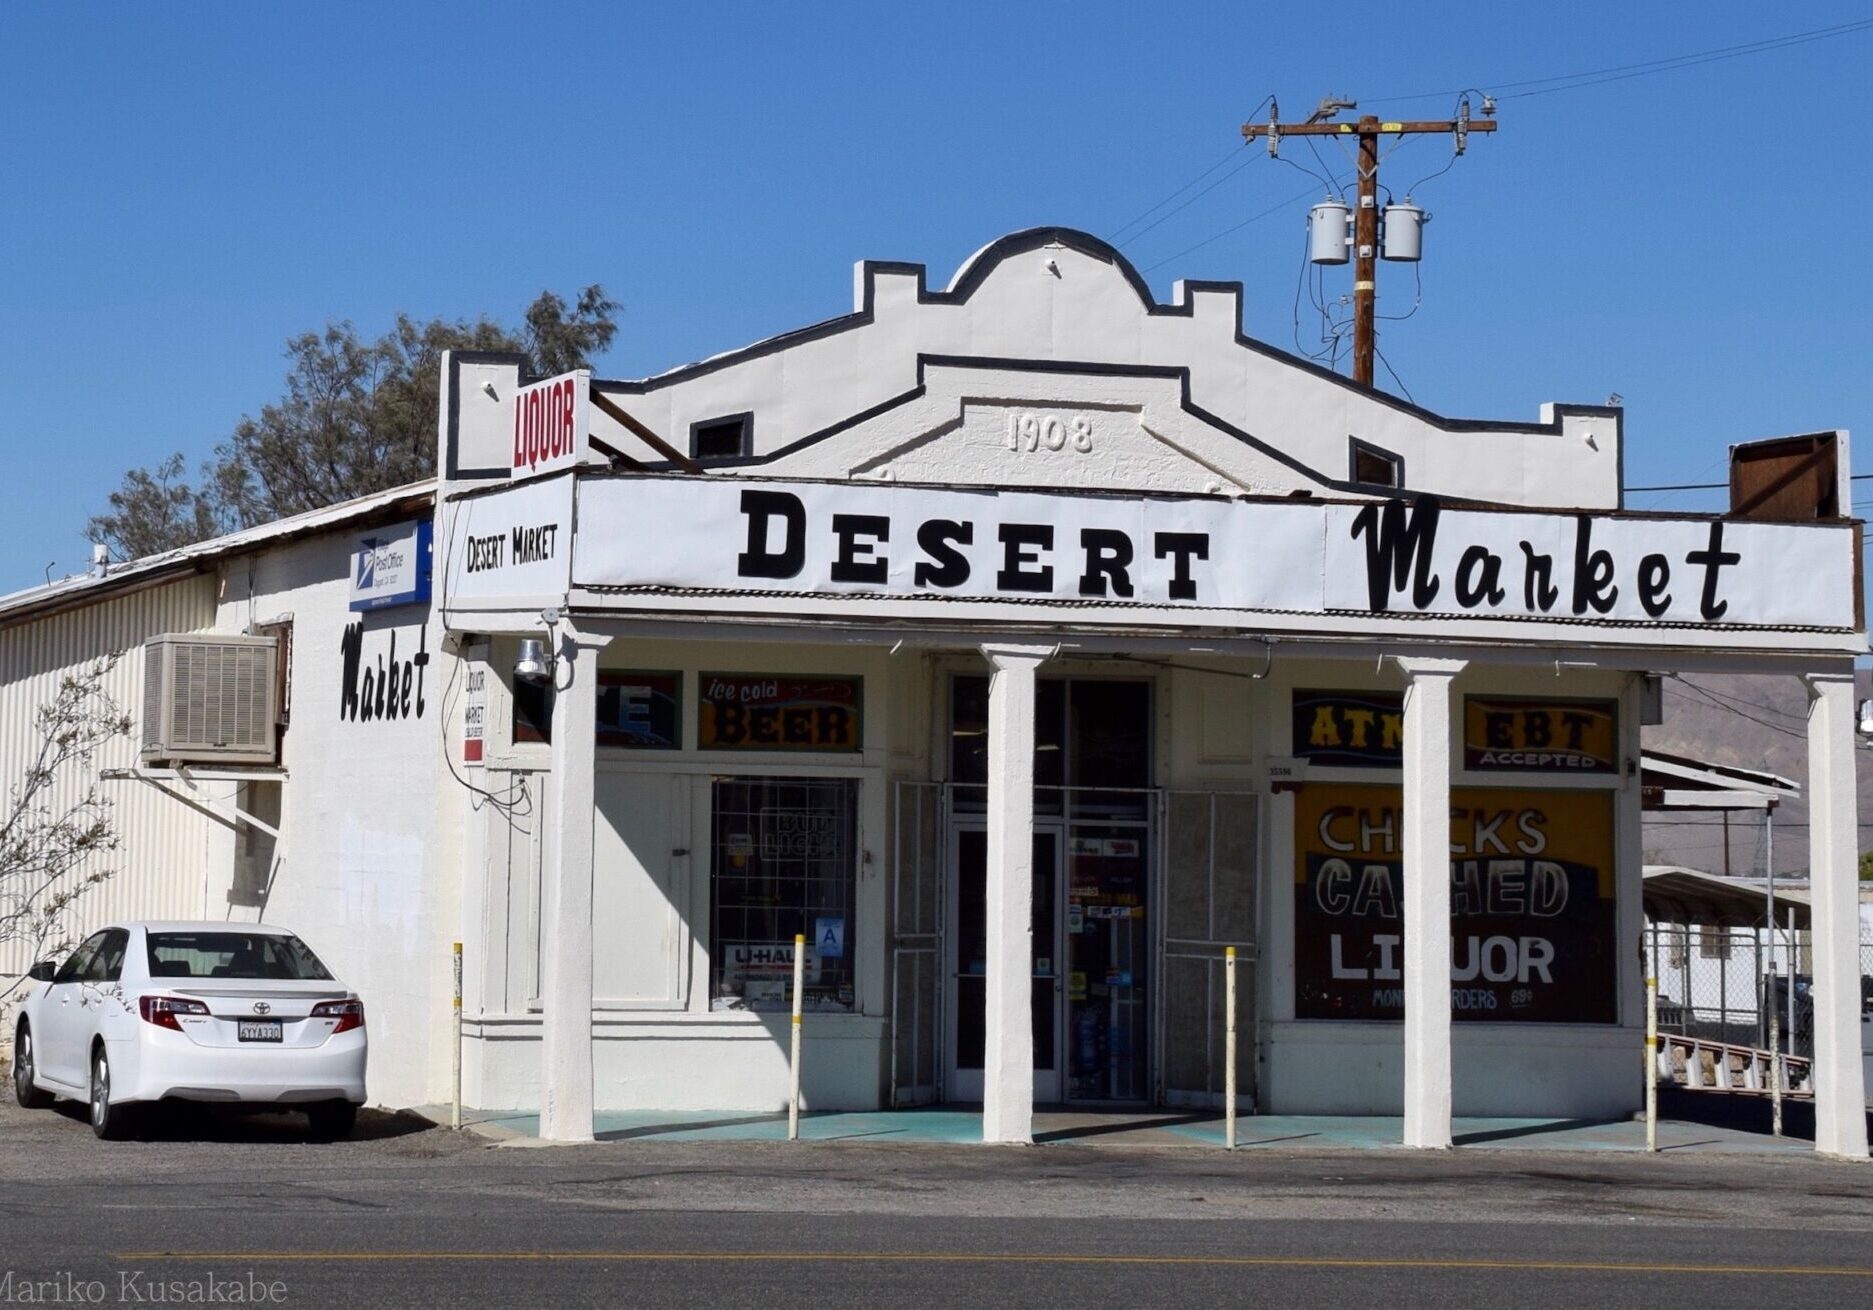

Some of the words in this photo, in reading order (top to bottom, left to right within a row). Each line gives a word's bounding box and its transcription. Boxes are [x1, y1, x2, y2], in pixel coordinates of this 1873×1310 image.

[514, 379, 574, 473] LIQUOR
[1009, 412, 1093, 454] 1908
[466, 534, 506, 574] DESERT
[511, 523, 558, 566] MARKET
[738, 490, 1209, 600] DESERT
[1350, 496, 1742, 620] Market
[341, 621, 430, 723] Market
[466, 671, 484, 694] LIQUOR
[708, 679, 736, 699] ice
[740, 681, 778, 701] cold
[713, 703, 848, 744] BEER
[1486, 711, 1593, 749] EBT
[1479, 751, 1596, 768] ACCEPTED
[1315, 857, 1570, 918] CAHED
[824, 928, 836, 944] A
[1330, 934, 1555, 983] LIUOR
[1450, 990, 1497, 1009] RDERS
